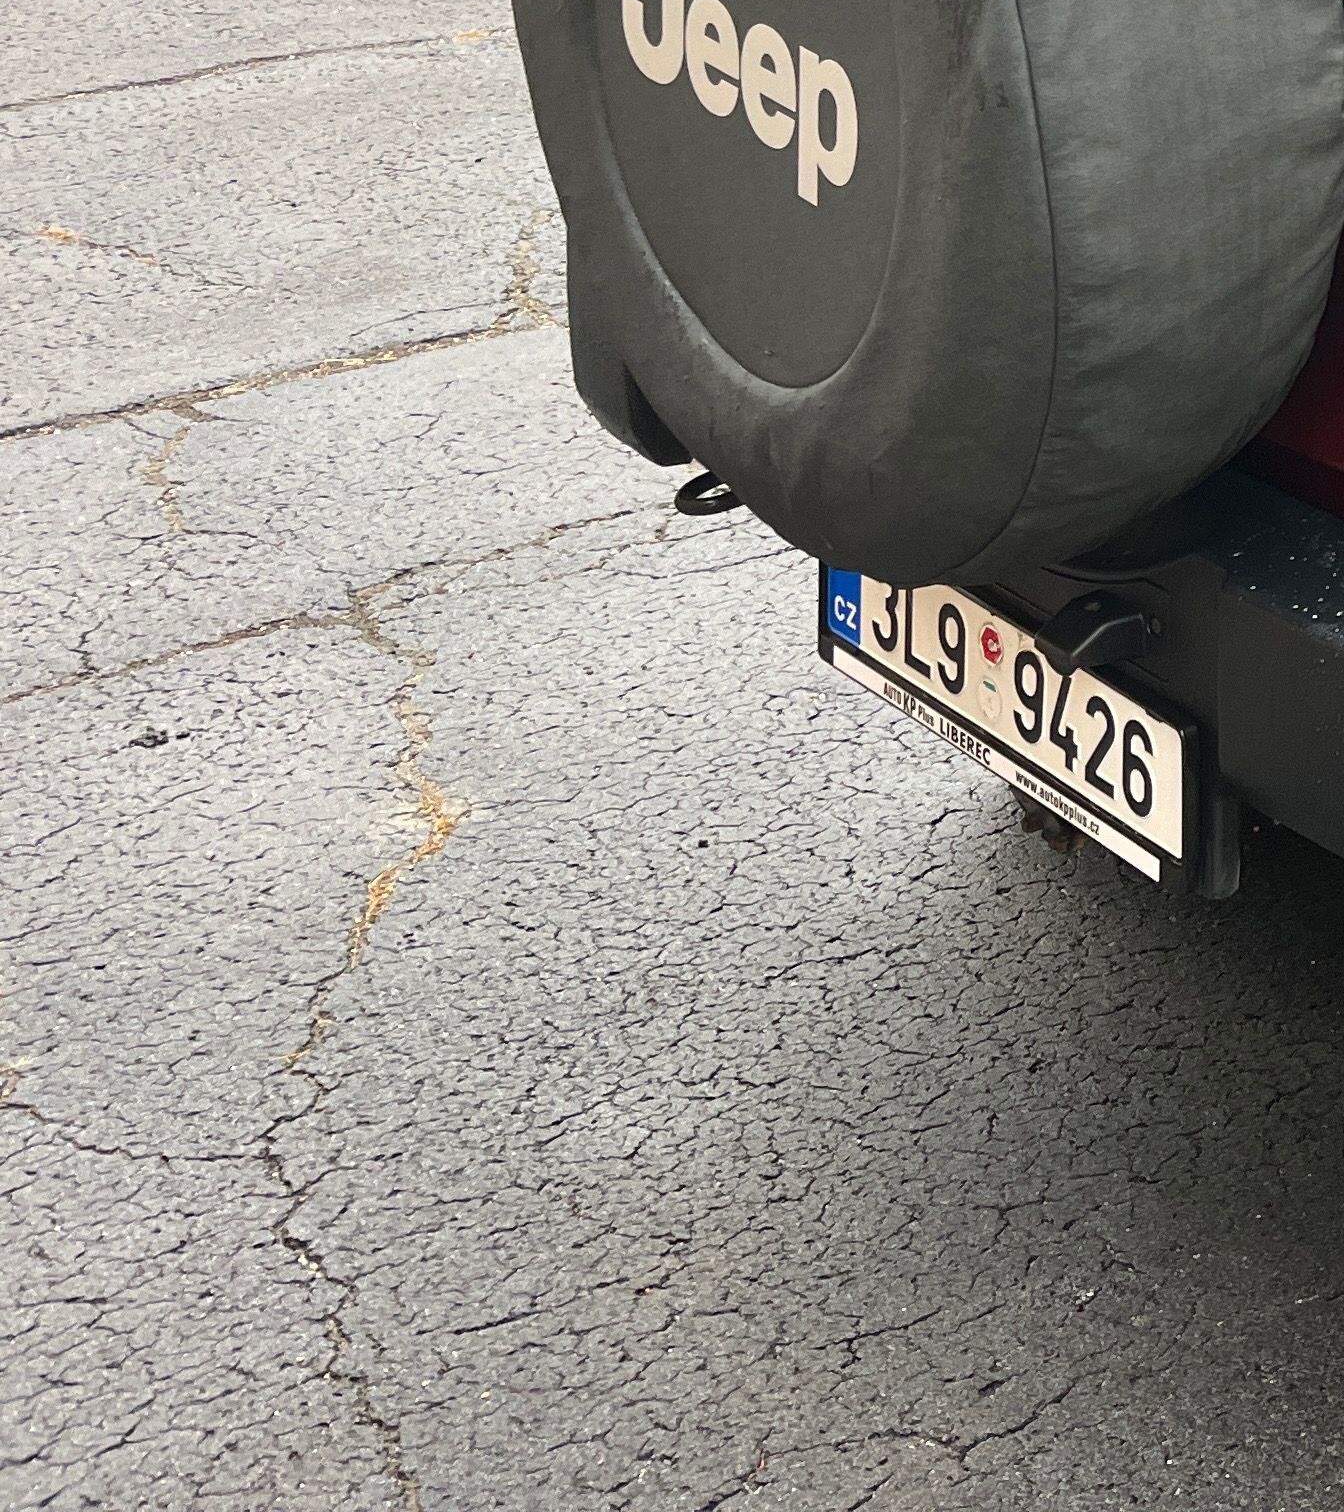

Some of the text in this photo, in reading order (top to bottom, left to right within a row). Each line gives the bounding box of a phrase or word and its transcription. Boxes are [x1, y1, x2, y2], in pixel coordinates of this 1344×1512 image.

[834, 595, 857, 630] CZ
[872, 586, 1153, 818] 3L9 9426
[883, 682, 902, 706] AUTO
[903, 691, 917, 719] KP
[939, 718, 992, 766] LIBEREC
[1015, 770, 1101, 836] www.autokpplus.cz
